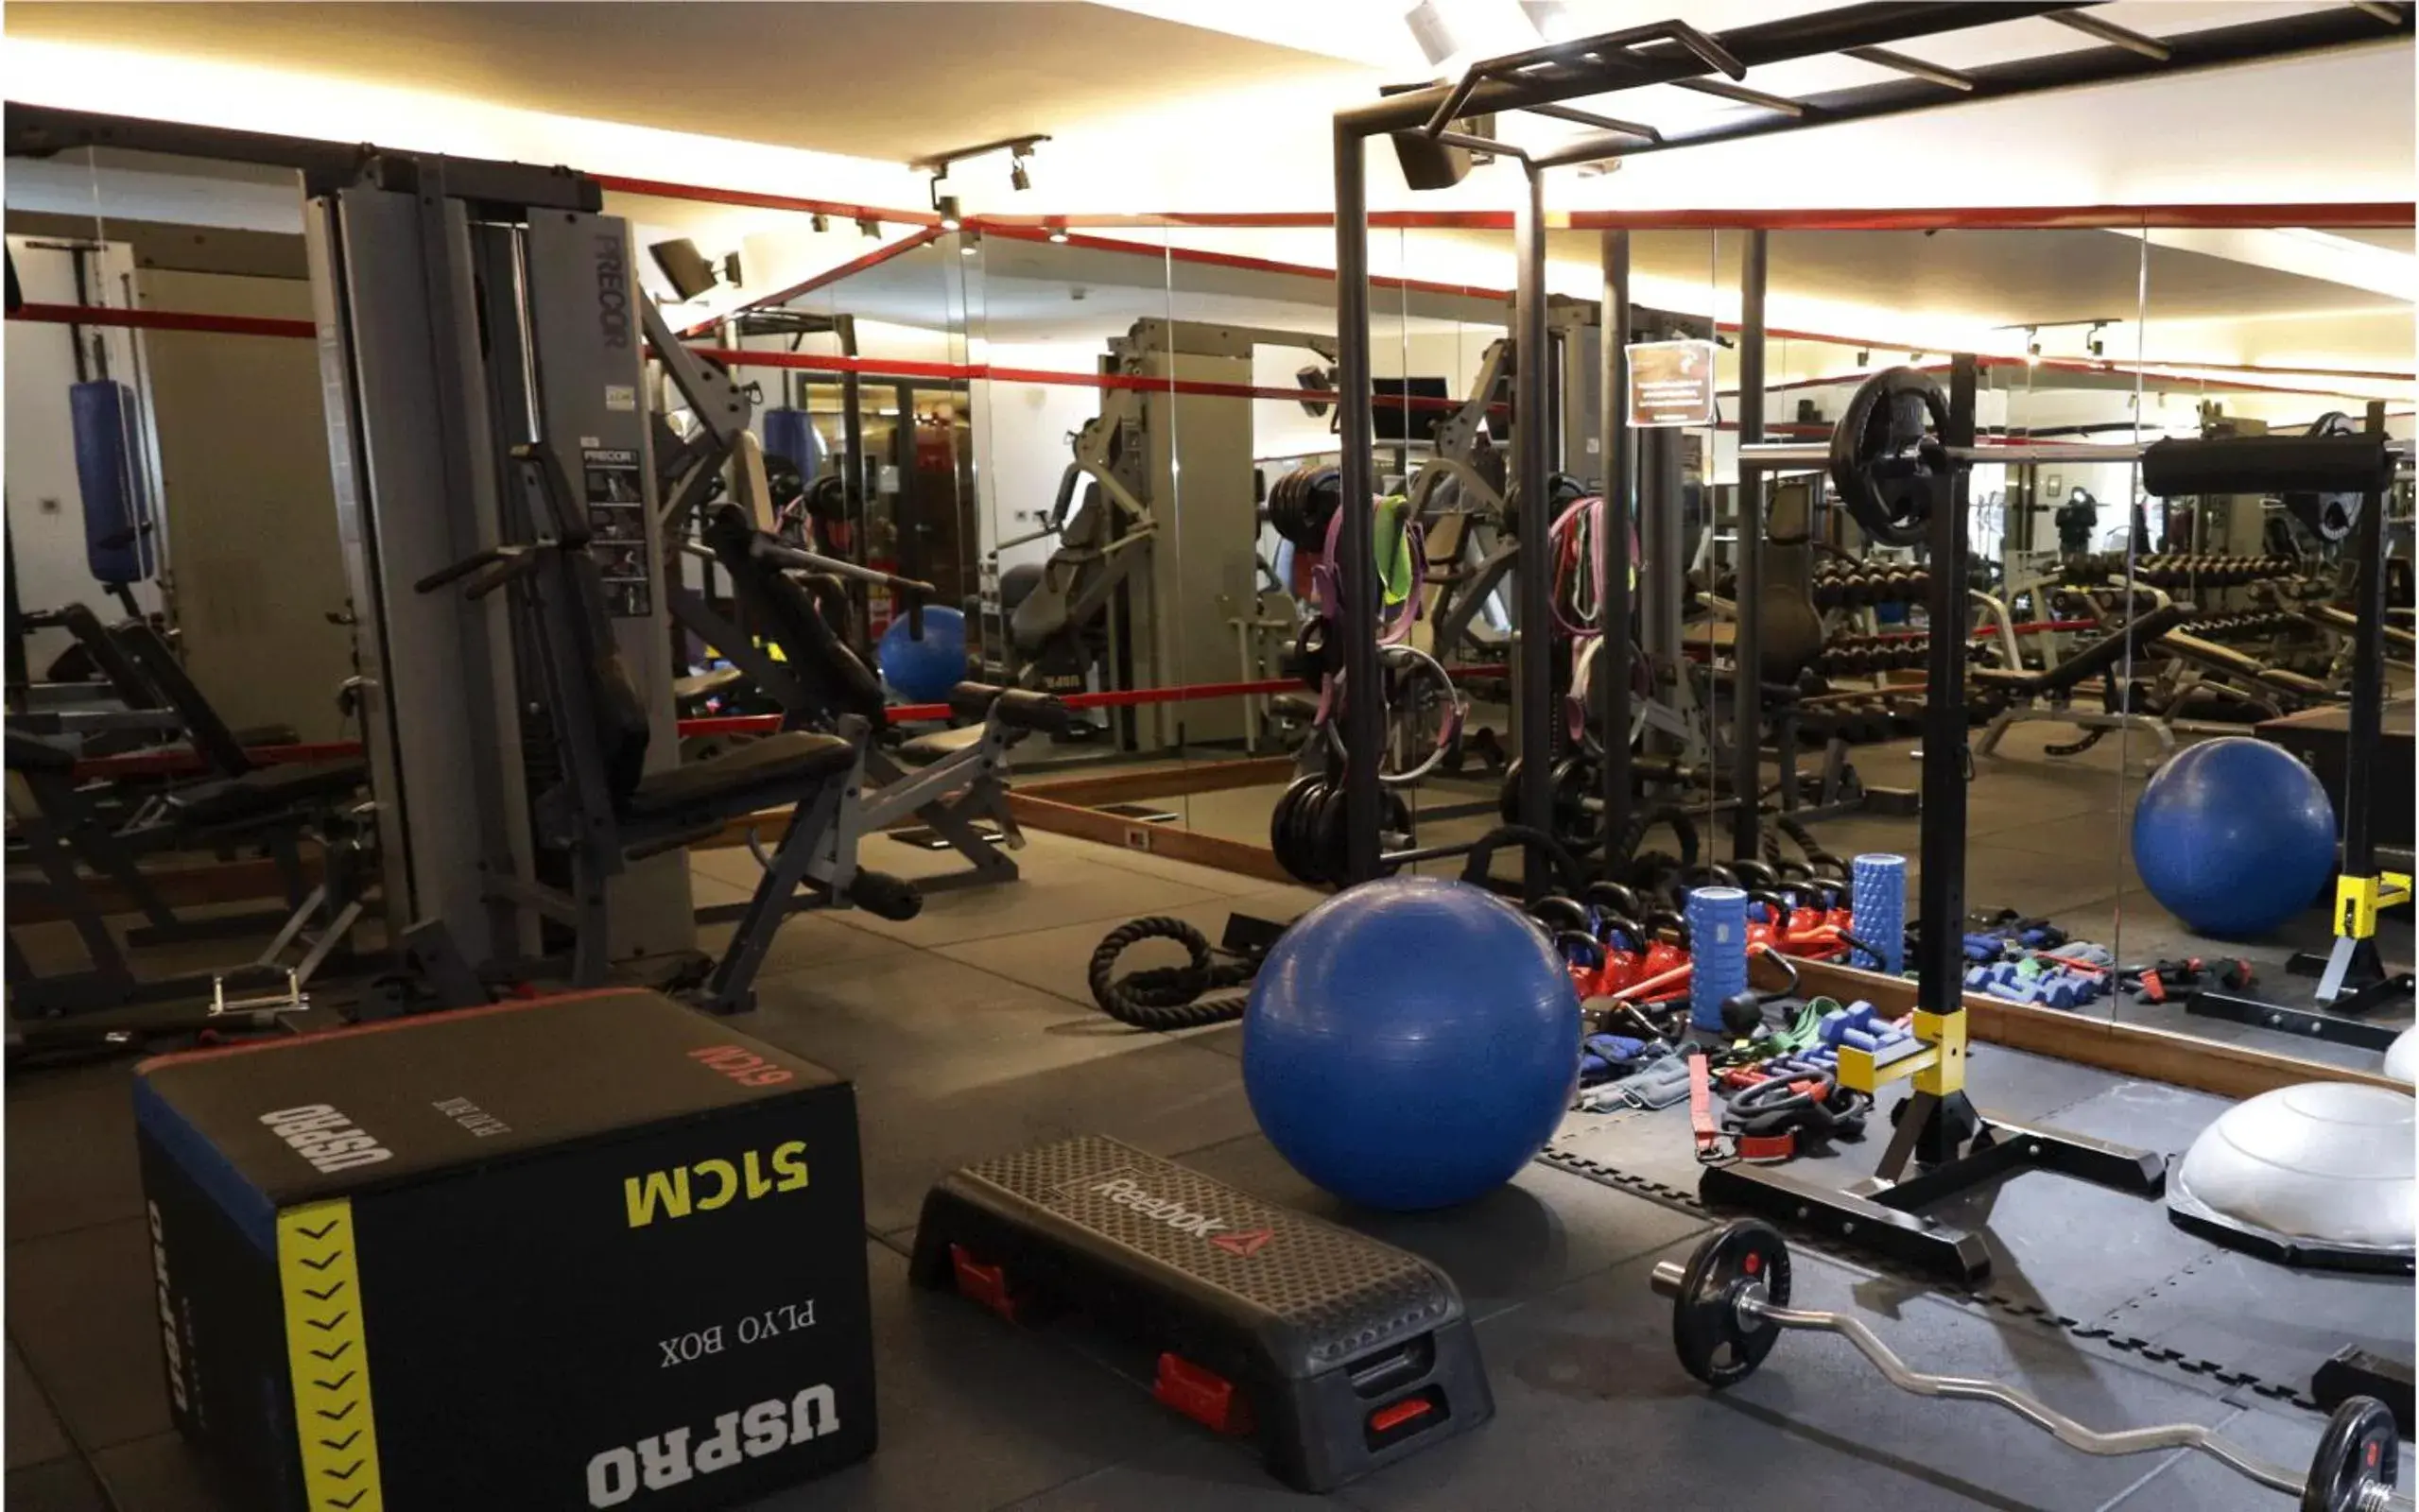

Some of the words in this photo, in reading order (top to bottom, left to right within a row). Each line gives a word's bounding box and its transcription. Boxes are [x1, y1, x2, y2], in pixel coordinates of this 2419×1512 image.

[594, 234, 629, 350] PRECOR
[686, 1044, 793, 1086] 61CM
[258, 1104, 394, 1174] USPRO
[624, 1141, 808, 1228] 51CM
[1090, 1179, 1230, 1238] Reebok
[659, 1325, 724, 1367] BOX
[738, 1298, 816, 1344] PLYO
[586, 1383, 840, 1508] USPRO
